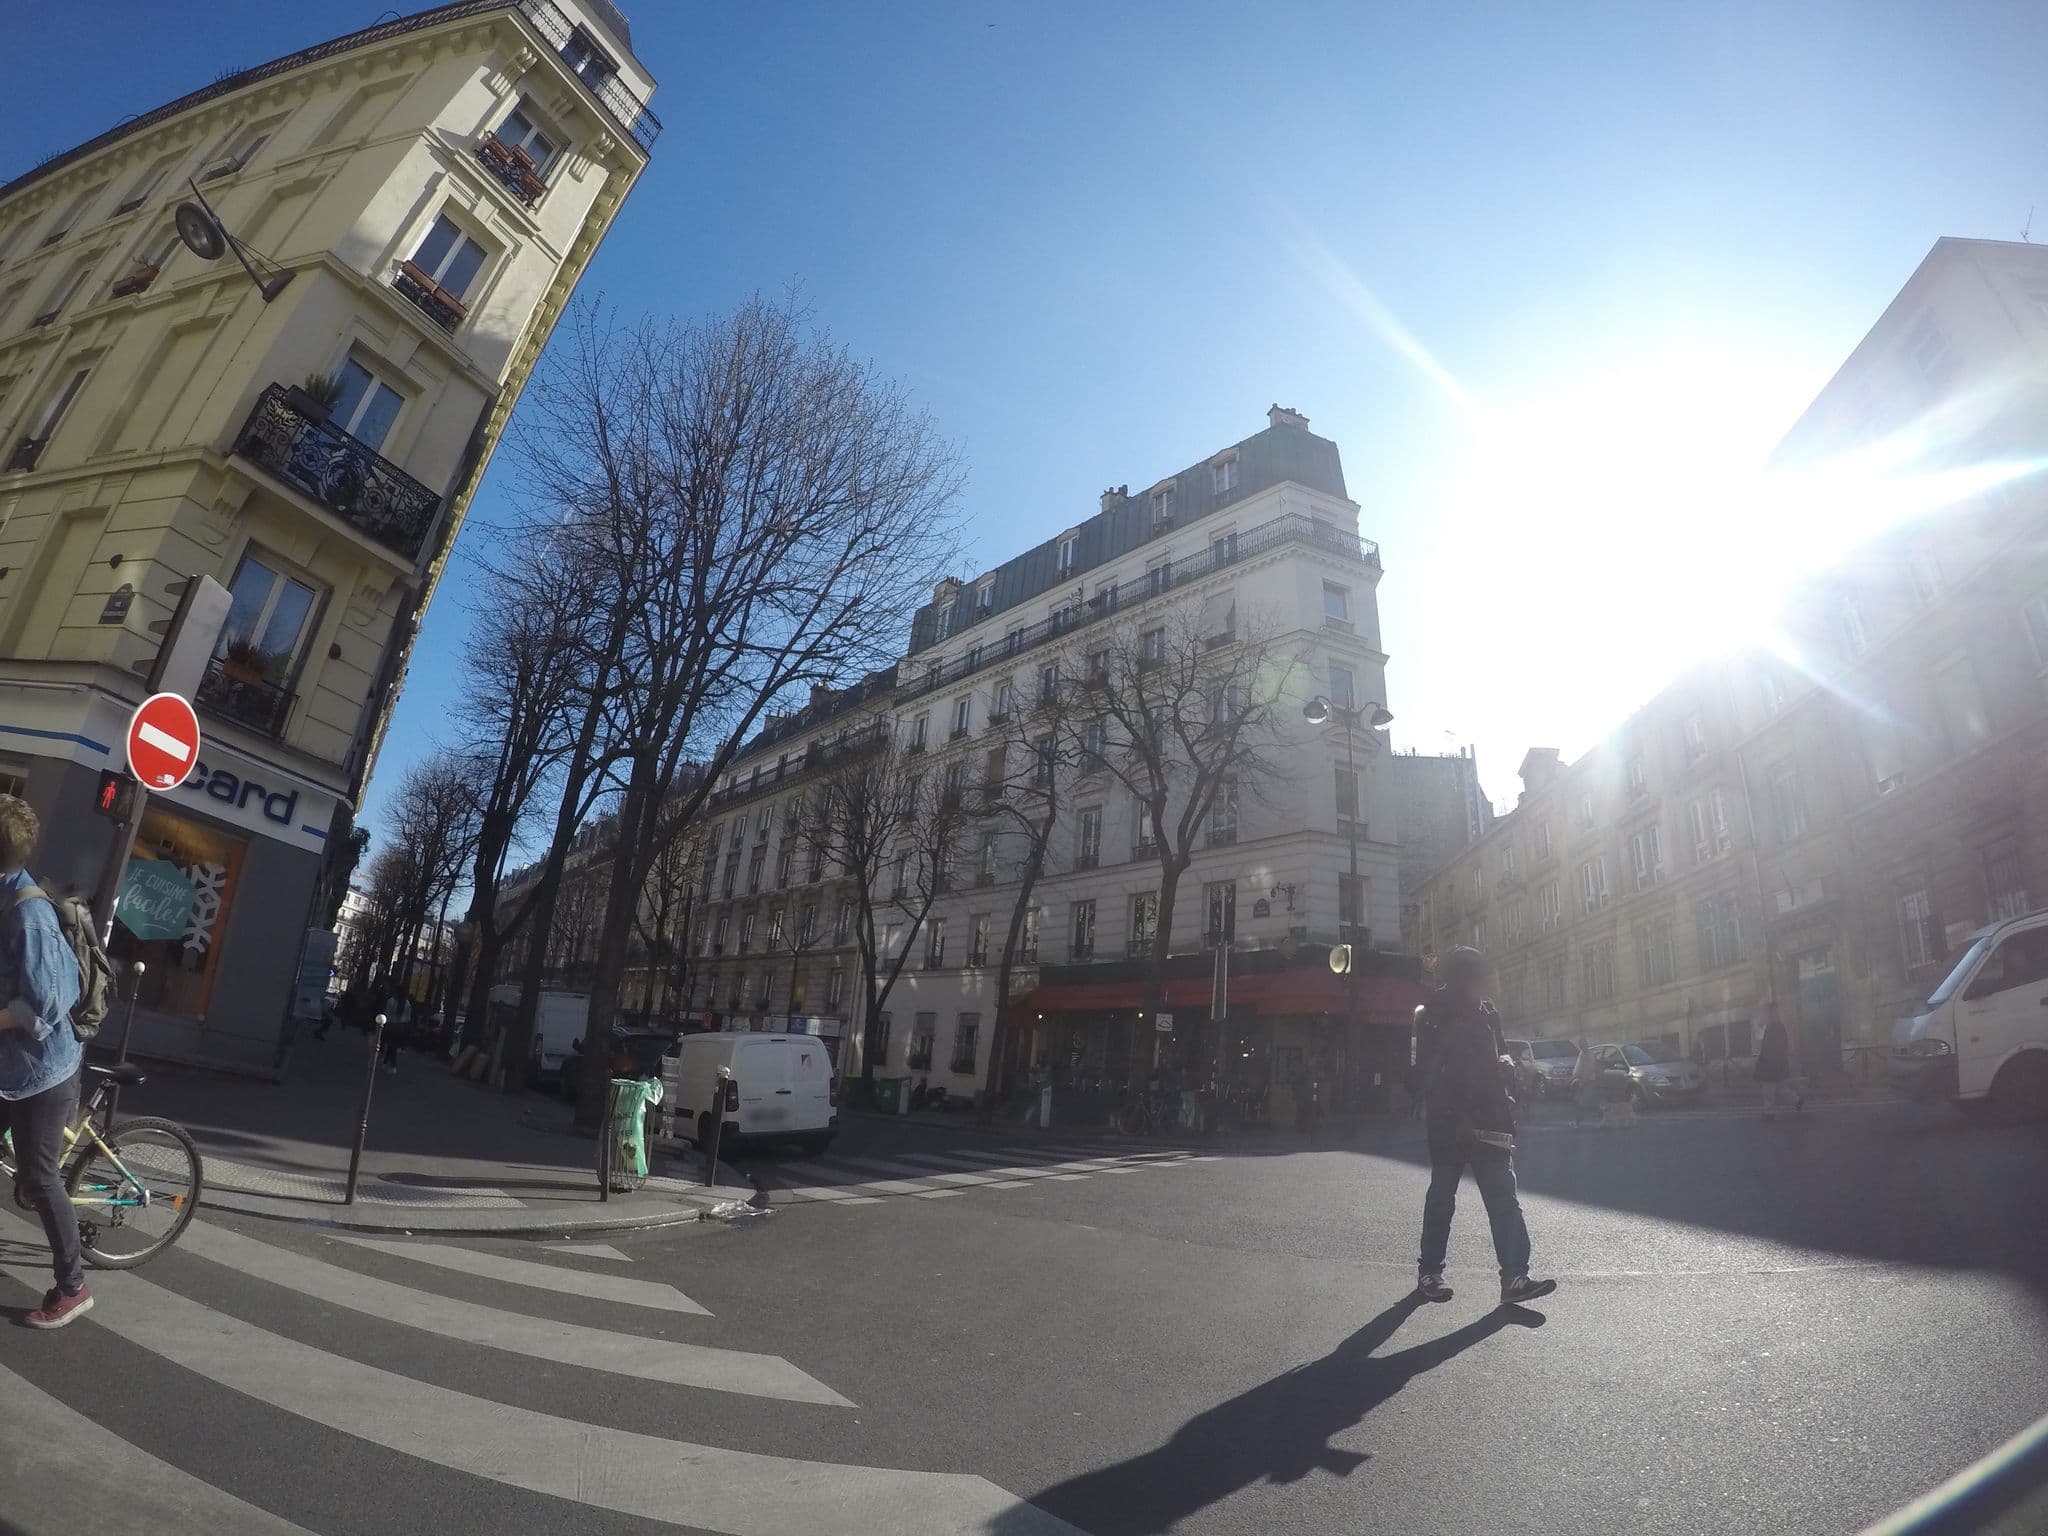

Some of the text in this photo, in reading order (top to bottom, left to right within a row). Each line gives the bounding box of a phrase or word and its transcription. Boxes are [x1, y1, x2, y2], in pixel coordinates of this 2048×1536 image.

[123, 758, 299, 826] card
[122, 882, 186, 925] facile!
[127, 866, 189, 901] JE CUISINE
